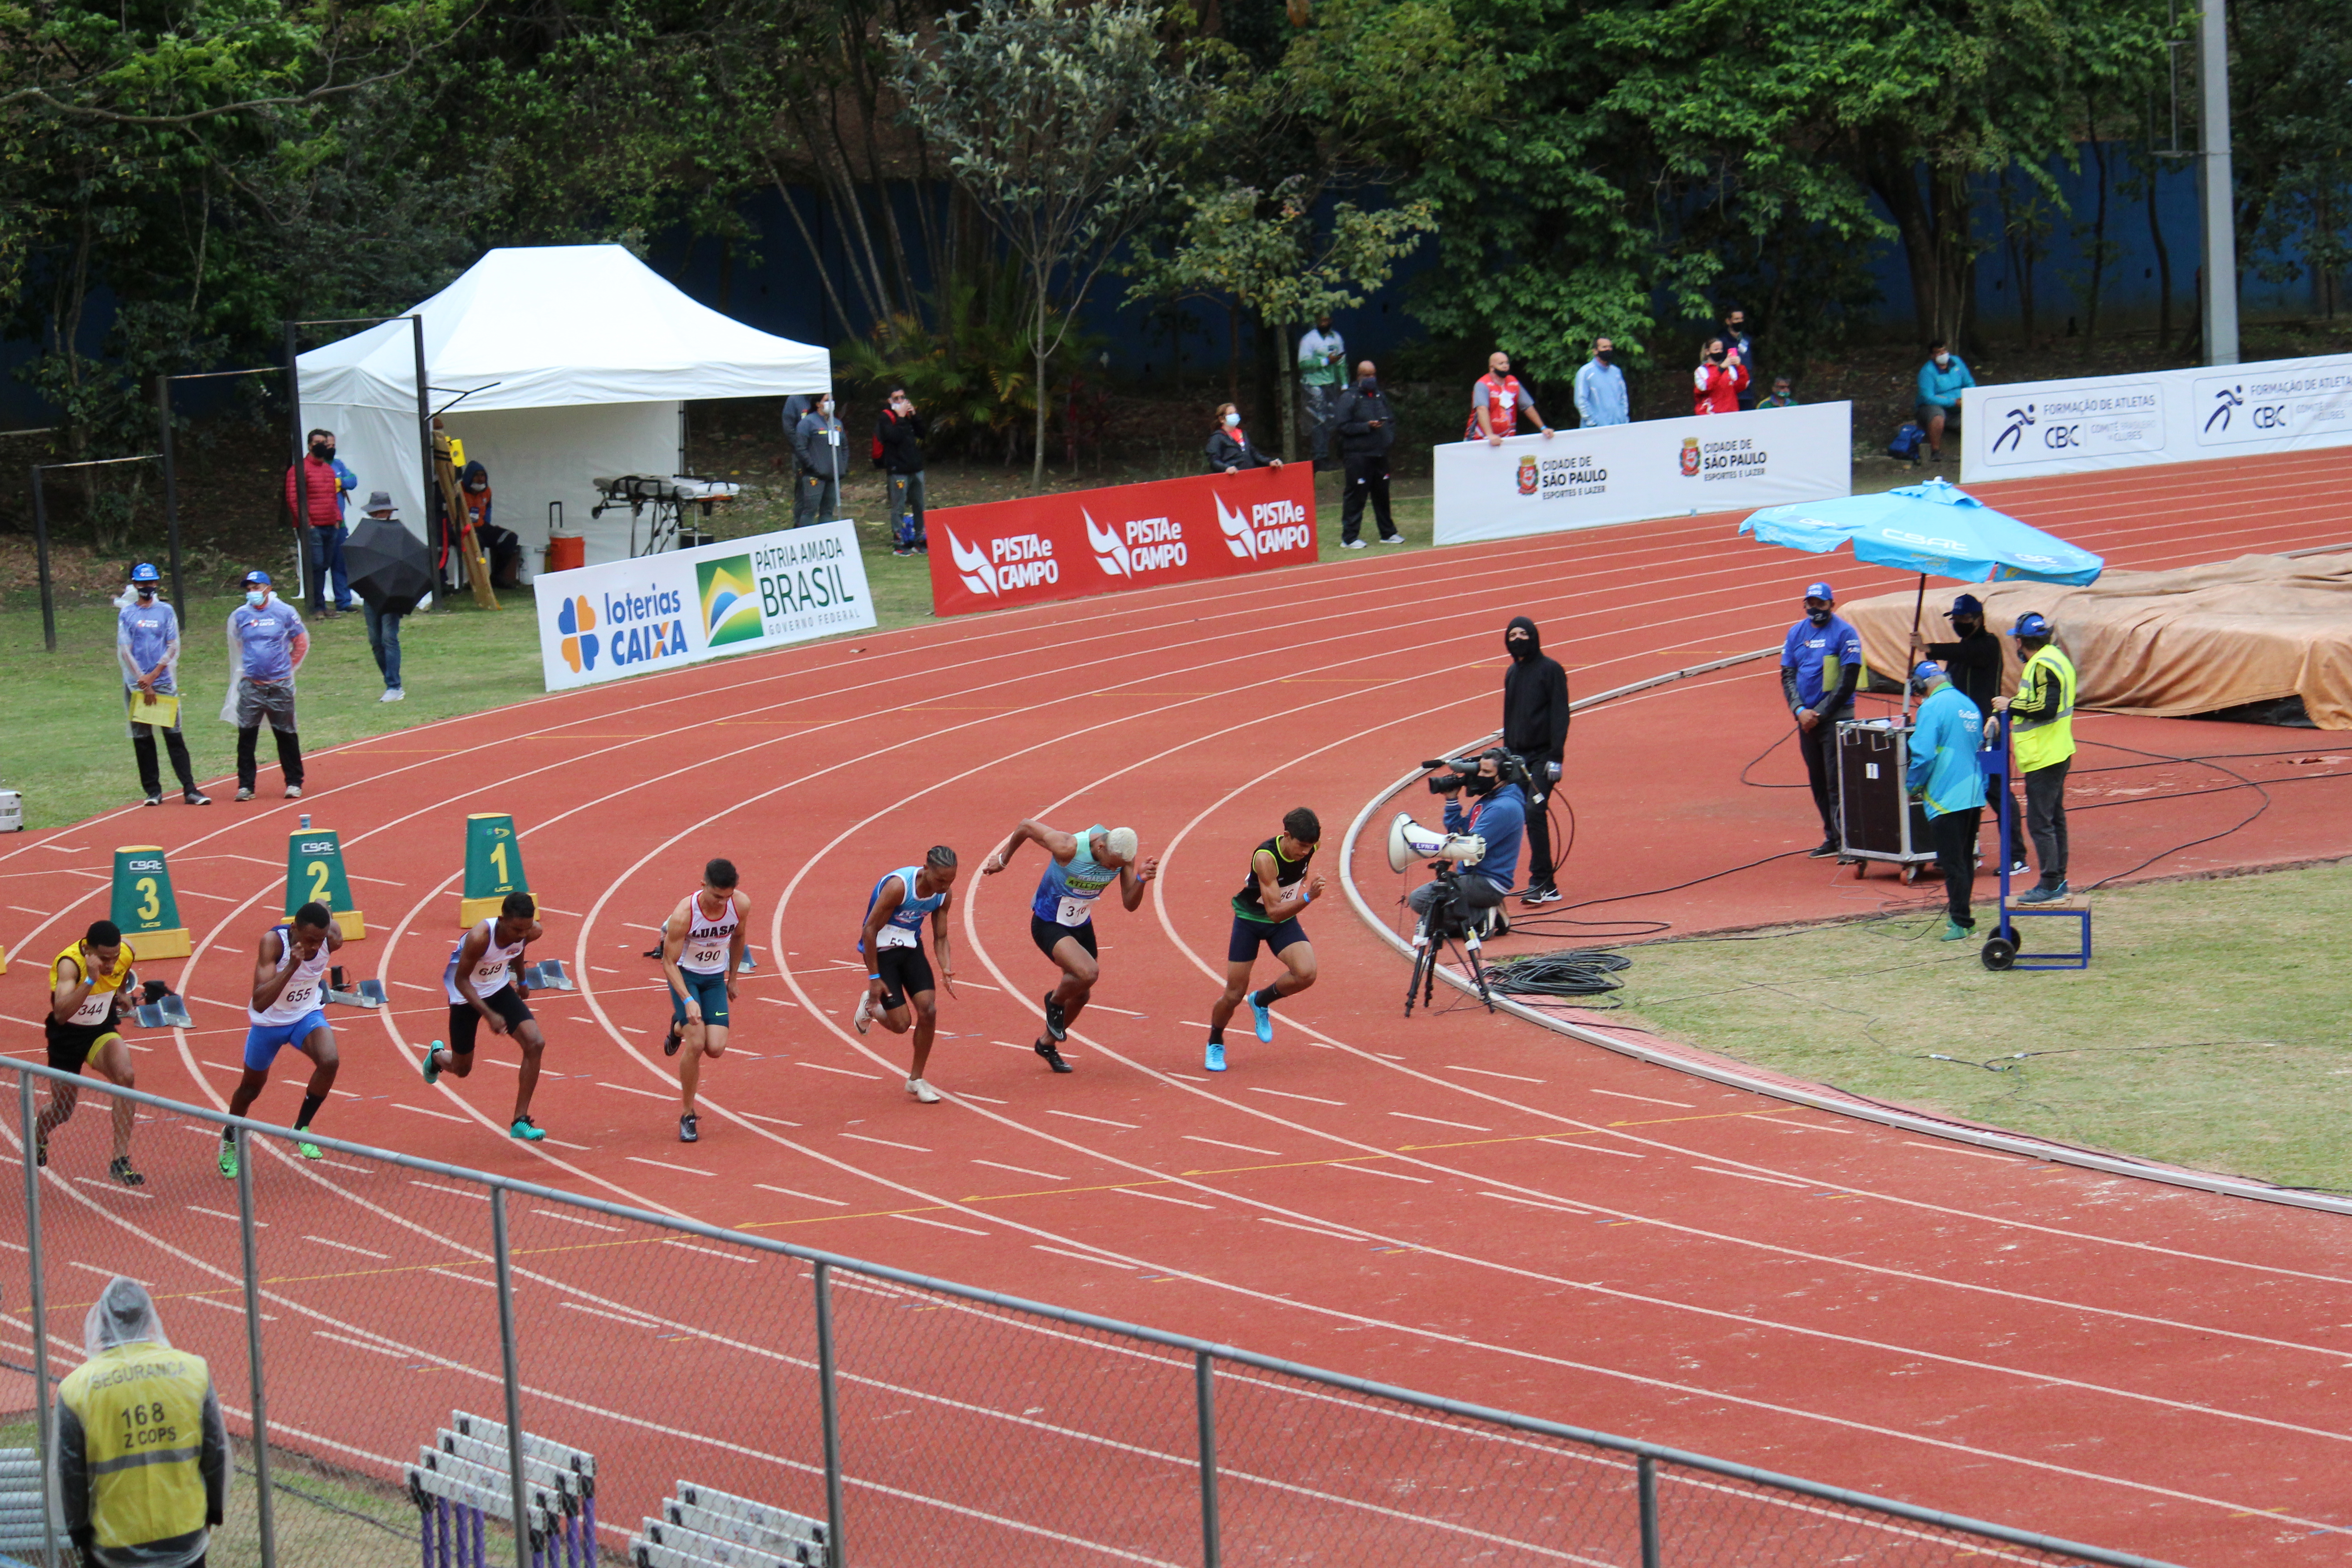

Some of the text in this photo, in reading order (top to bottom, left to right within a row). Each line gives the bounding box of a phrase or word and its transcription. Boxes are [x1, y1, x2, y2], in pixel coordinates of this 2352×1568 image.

[2251, 379, 2303, 396] FORMAÇÃO
[2305, 379, 2317, 390] DE
[2043, 395, 2155, 415] FORMAÇÃO DE ATLETAS
[2253, 405, 2286, 428] CBC
[1705, 439, 1753, 453] CIDADE DE
[2044, 425, 2080, 449] CBC
[1543, 456, 1592, 471] CIDADE DE
[1705, 451, 1767, 470] SÃO PAULO
[1543, 469, 1607, 488] SÃO PAULO
[1705, 471, 1737, 481] ESPORTES
[1744, 468, 1765, 477] LAZER
[1543, 489, 1576, 500] ESPORTES
[1584, 485, 1606, 495] LAZER
[1257, 524, 1310, 554] CAMPO
[755, 537, 844, 572] PÁTRIA AMADA
[1131, 542, 1187, 572] CAMPO
[998, 559, 1059, 590] CAMPO
[760, 564, 854, 617] BRASIL
[604, 583, 681, 625] loterias
[768, 608, 860, 635] GOVERNO FEDERAL
[611, 620, 688, 666] CAIXA
[490, 843, 508, 884] 1
[307, 861, 332, 903] 2
[136, 877, 160, 920] 3
[692, 924, 735, 938] LUASA
[695, 951, 720, 961] 490
[479, 963, 502, 975] 649
[287, 988, 312, 1002] 655
[78, 1002, 103, 1016] 344
[121, 1402, 164, 1428] 168
[123, 1426, 176, 1448] Z COPS
